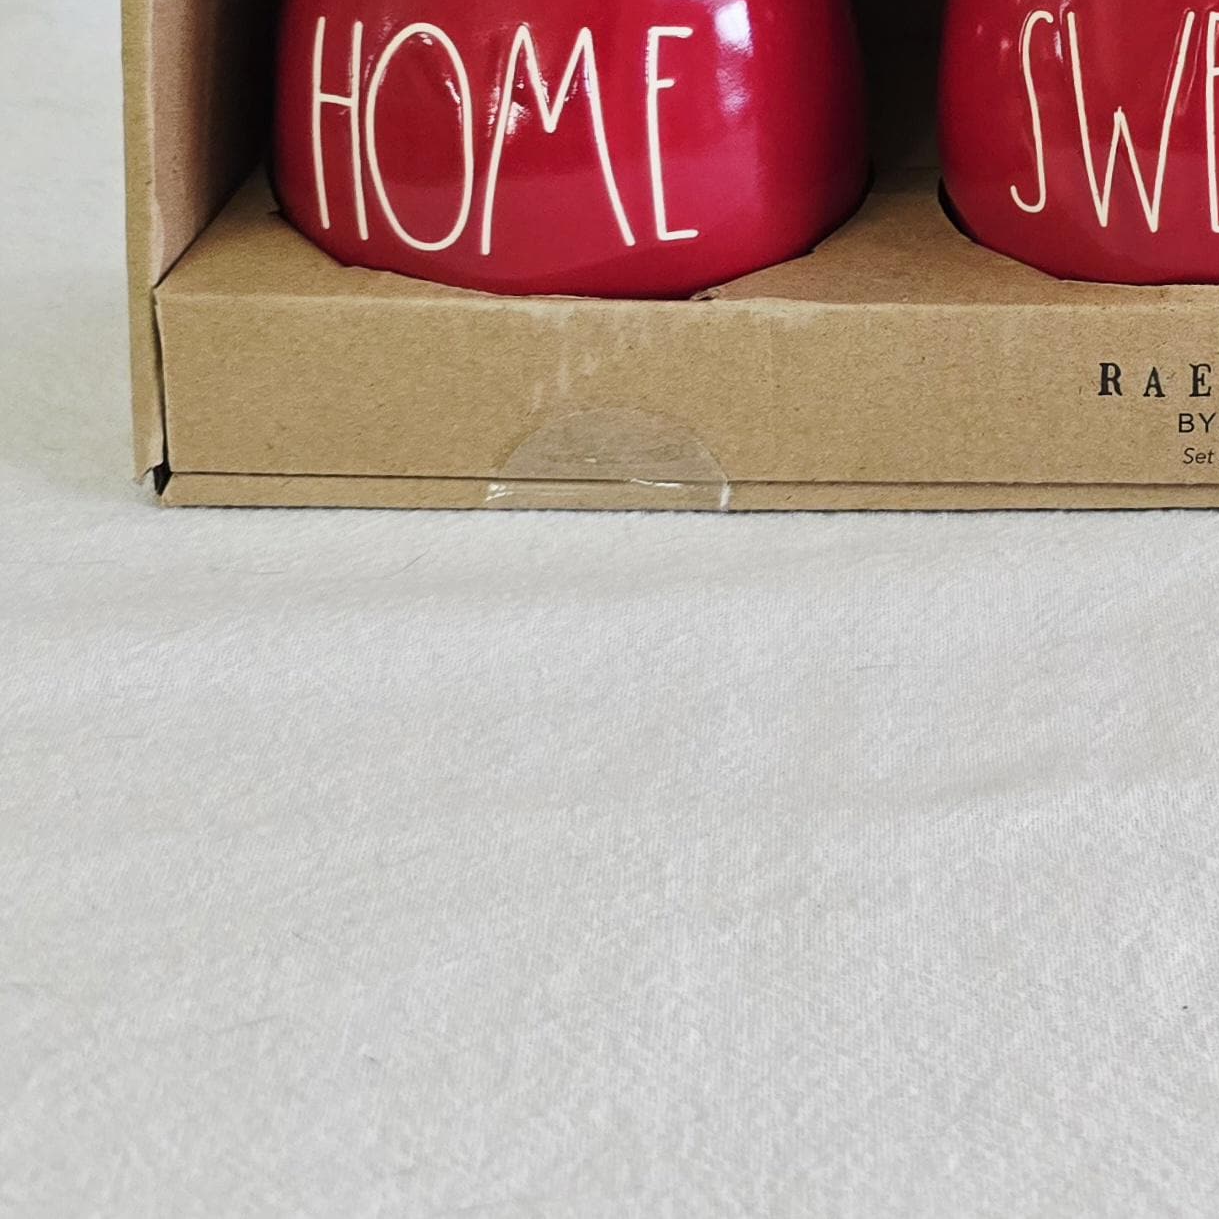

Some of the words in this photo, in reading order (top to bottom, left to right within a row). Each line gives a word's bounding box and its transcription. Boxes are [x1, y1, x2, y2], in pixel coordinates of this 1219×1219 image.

[312, 16, 699, 256] HOME
[1098, 362, 1212, 397] RAE
[1178, 413, 1216, 434] BY
[1182, 447, 1215, 465] Set
